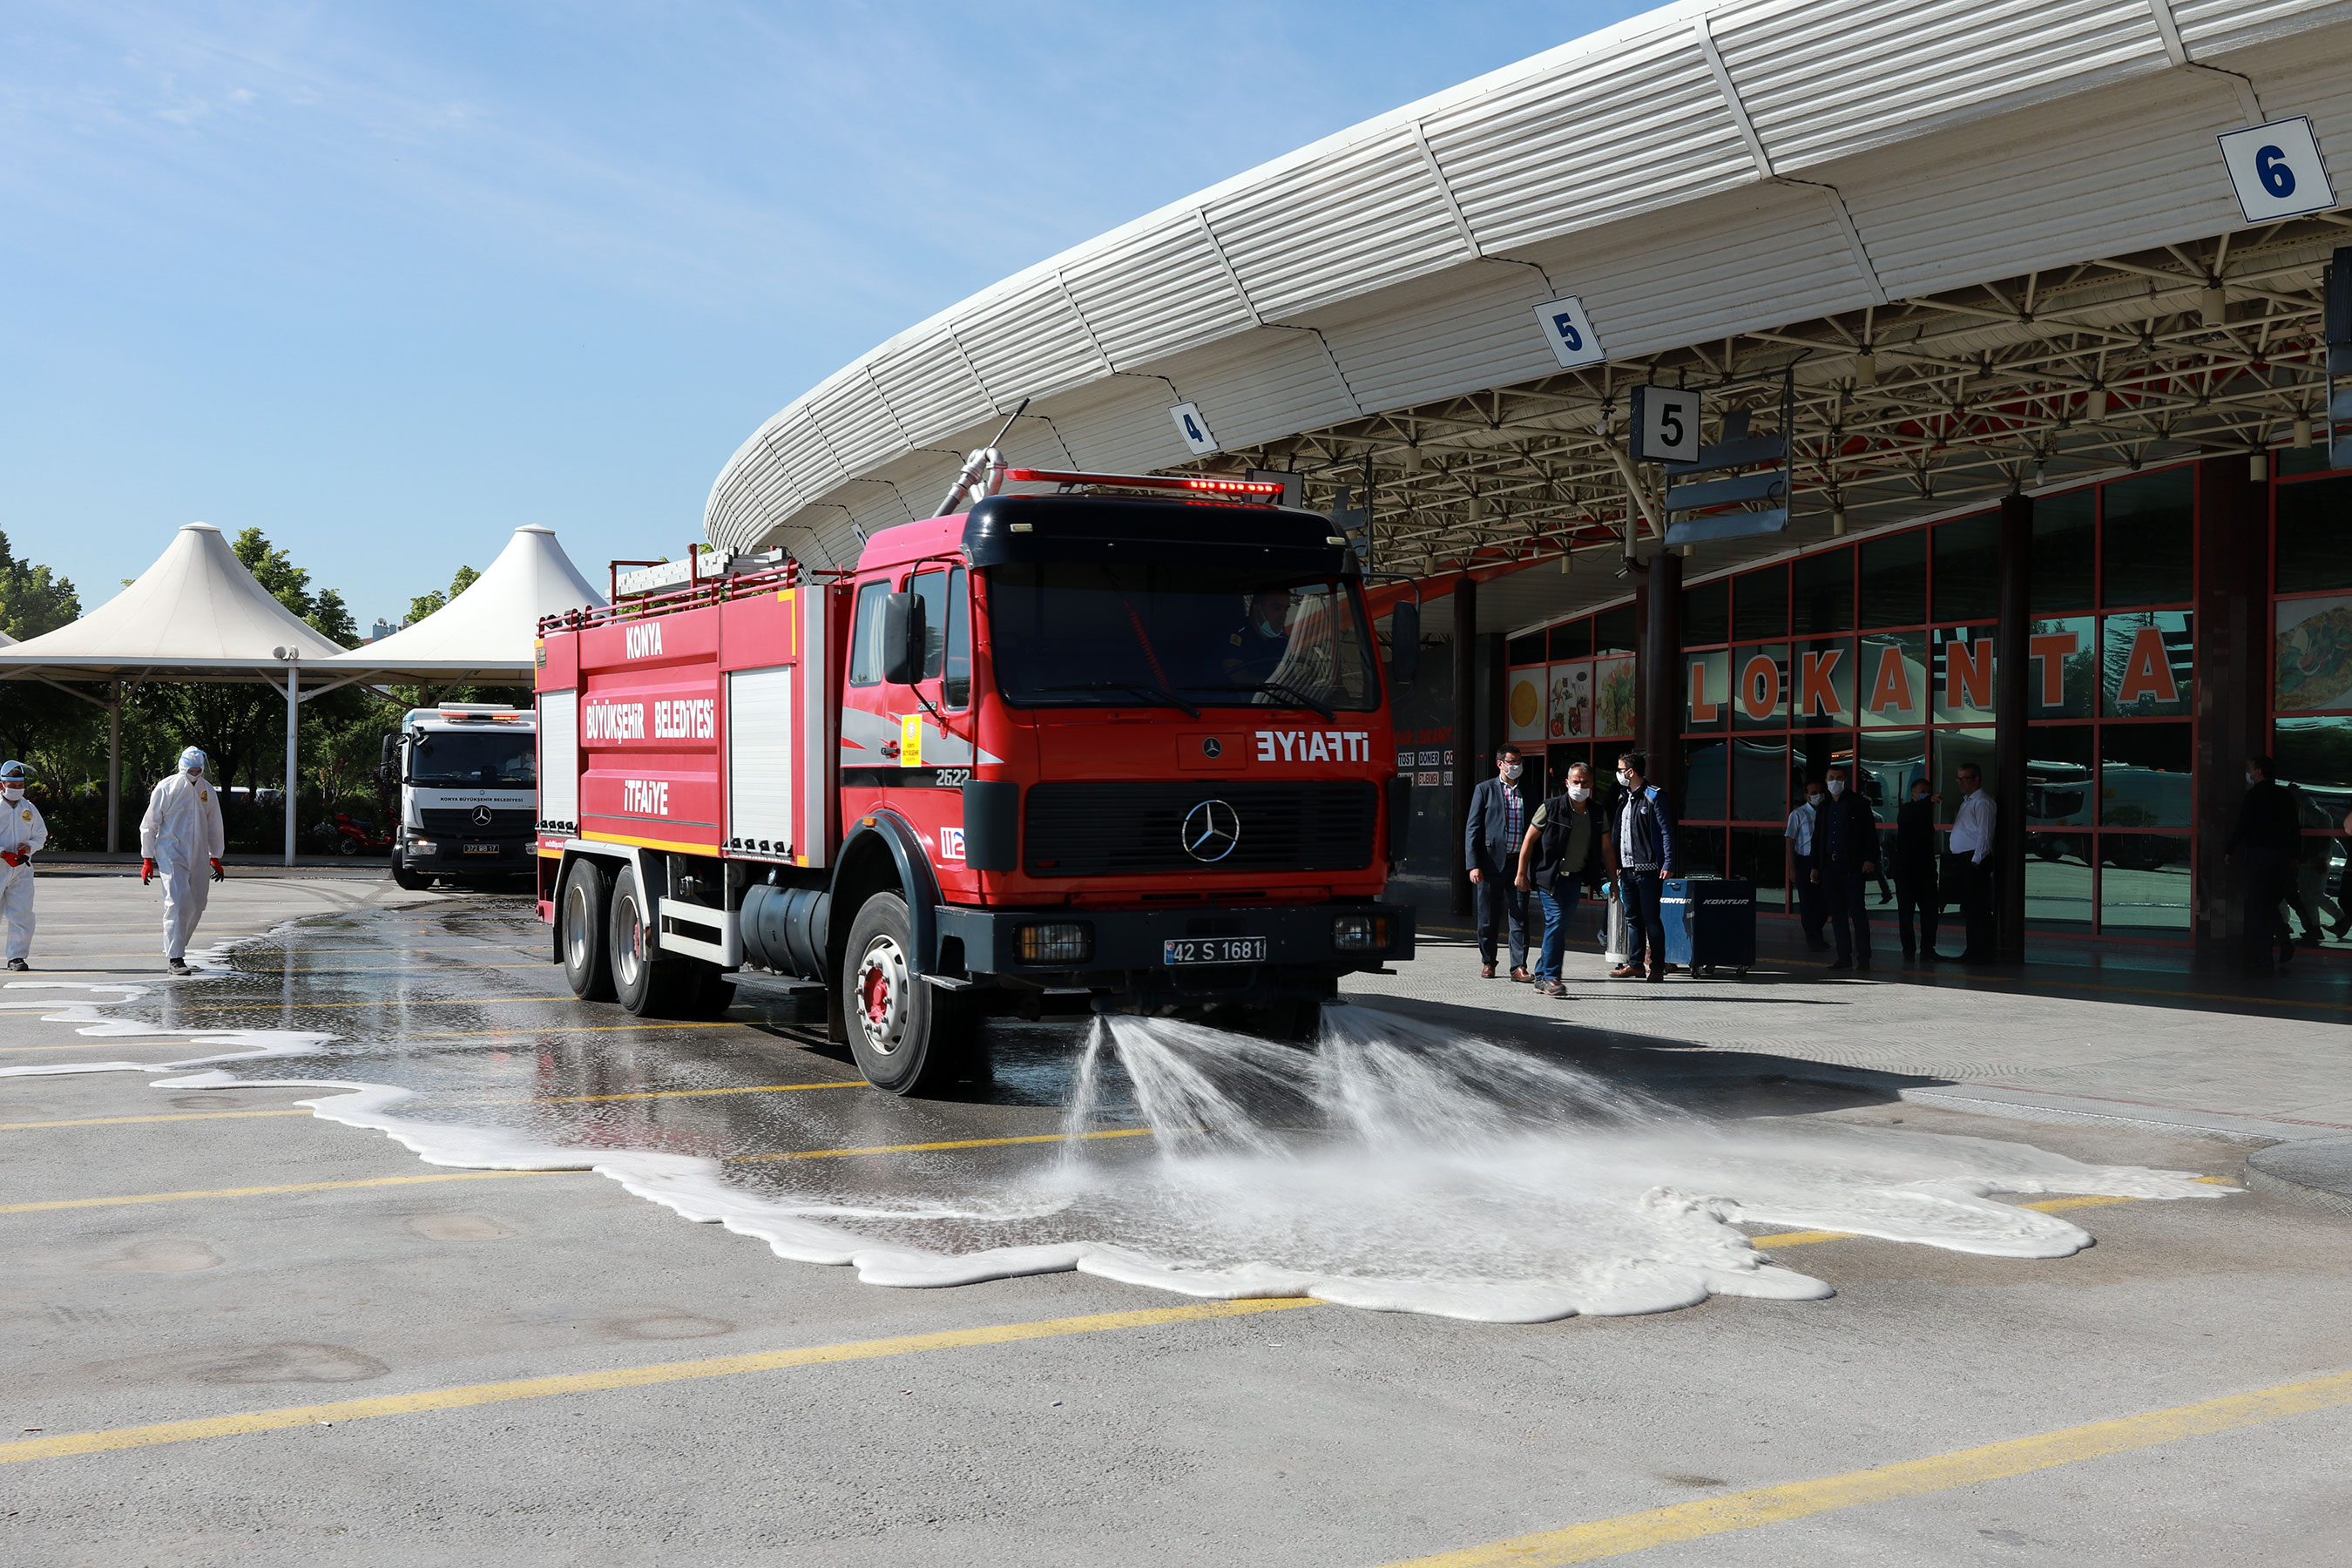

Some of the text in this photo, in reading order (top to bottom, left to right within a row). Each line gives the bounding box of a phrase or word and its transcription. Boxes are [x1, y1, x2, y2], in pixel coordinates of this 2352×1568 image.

[2255, 145, 2295, 199] 6
[1552, 312, 1583, 352] 5
[1183, 413, 1204, 443] 4
[1660, 403, 1684, 447] 5
[625, 621, 664, 659] KONYA
[1691, 625, 2180, 723] LOKANTA
[936, 768, 970, 787] 2622
[1398, 754, 1415, 765] TOST
[1173, 941, 1260, 961] 42 S 1681
